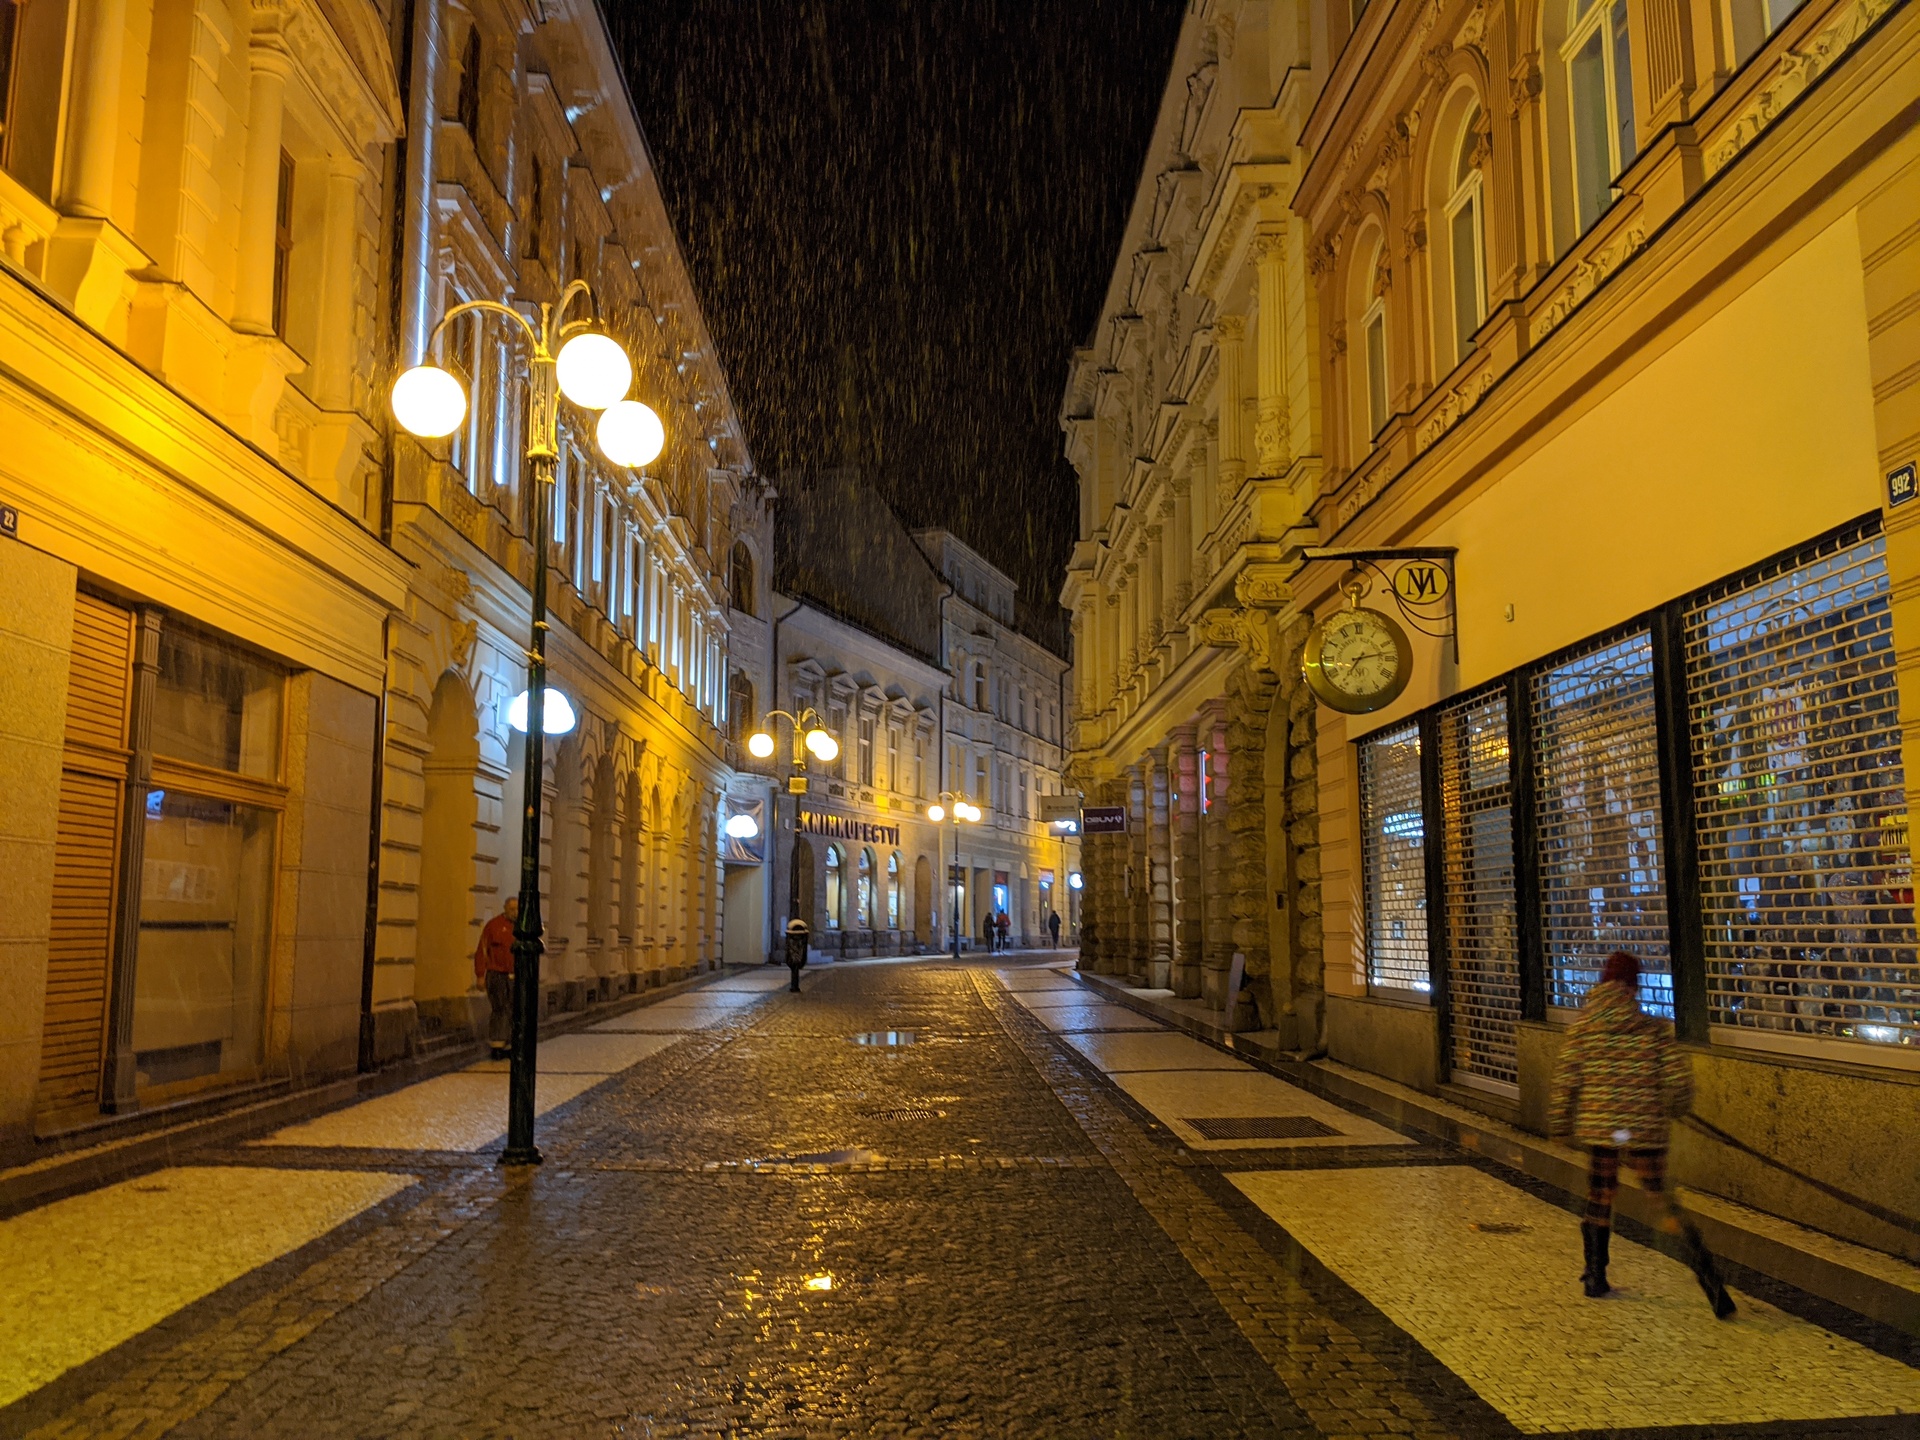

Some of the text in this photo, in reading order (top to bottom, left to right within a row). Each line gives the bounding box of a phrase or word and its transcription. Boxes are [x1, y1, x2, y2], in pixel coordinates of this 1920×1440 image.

[1891, 472, 1911, 497] 992
[3, 510, 15, 529] 22
[801, 811, 900, 846] KNIHKUPECTVÍ
